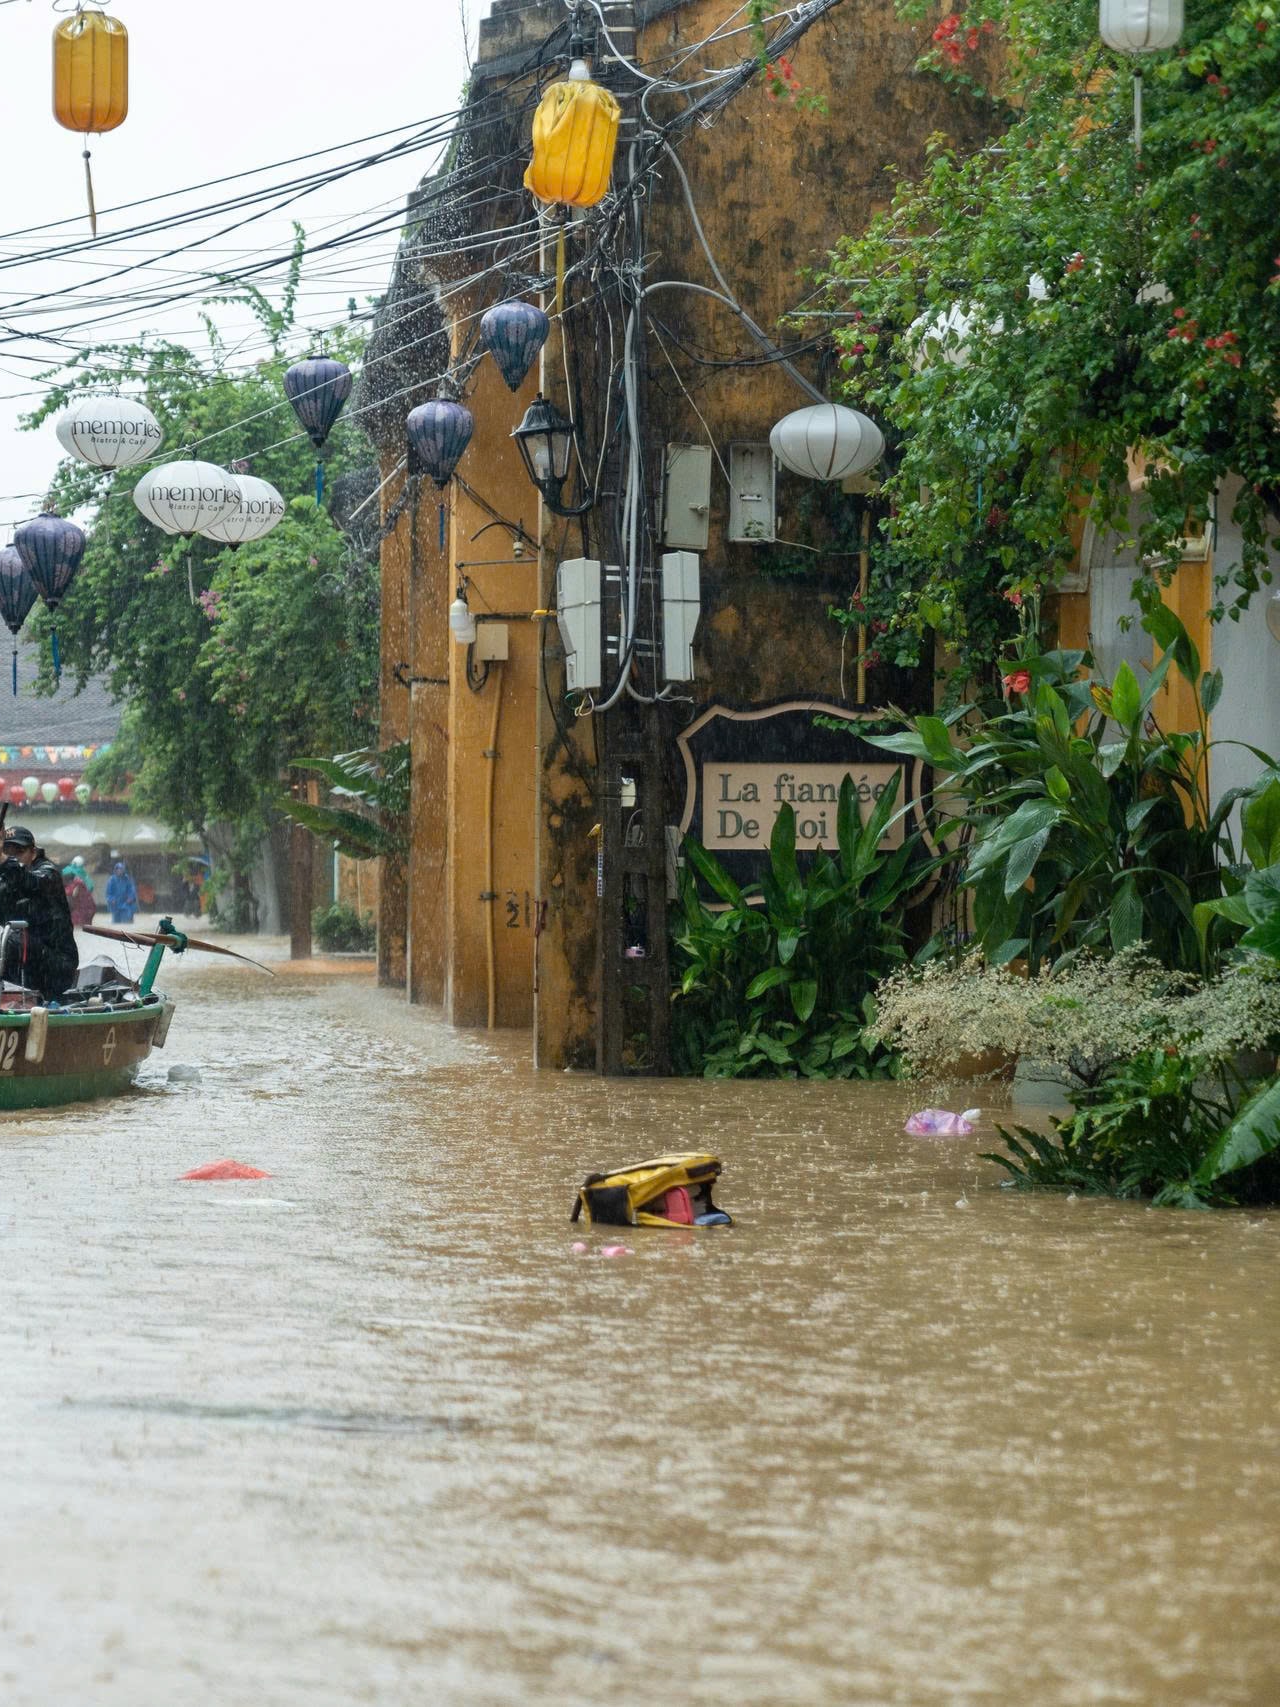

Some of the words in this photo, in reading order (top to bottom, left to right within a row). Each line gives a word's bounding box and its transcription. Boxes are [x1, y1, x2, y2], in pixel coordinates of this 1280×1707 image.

[73, 419, 161, 439] memories
[151, 485, 240, 505] memories
[718, 772, 761, 803] La
[773, 772, 887, 804] fianée
[716, 809, 761, 840] De
